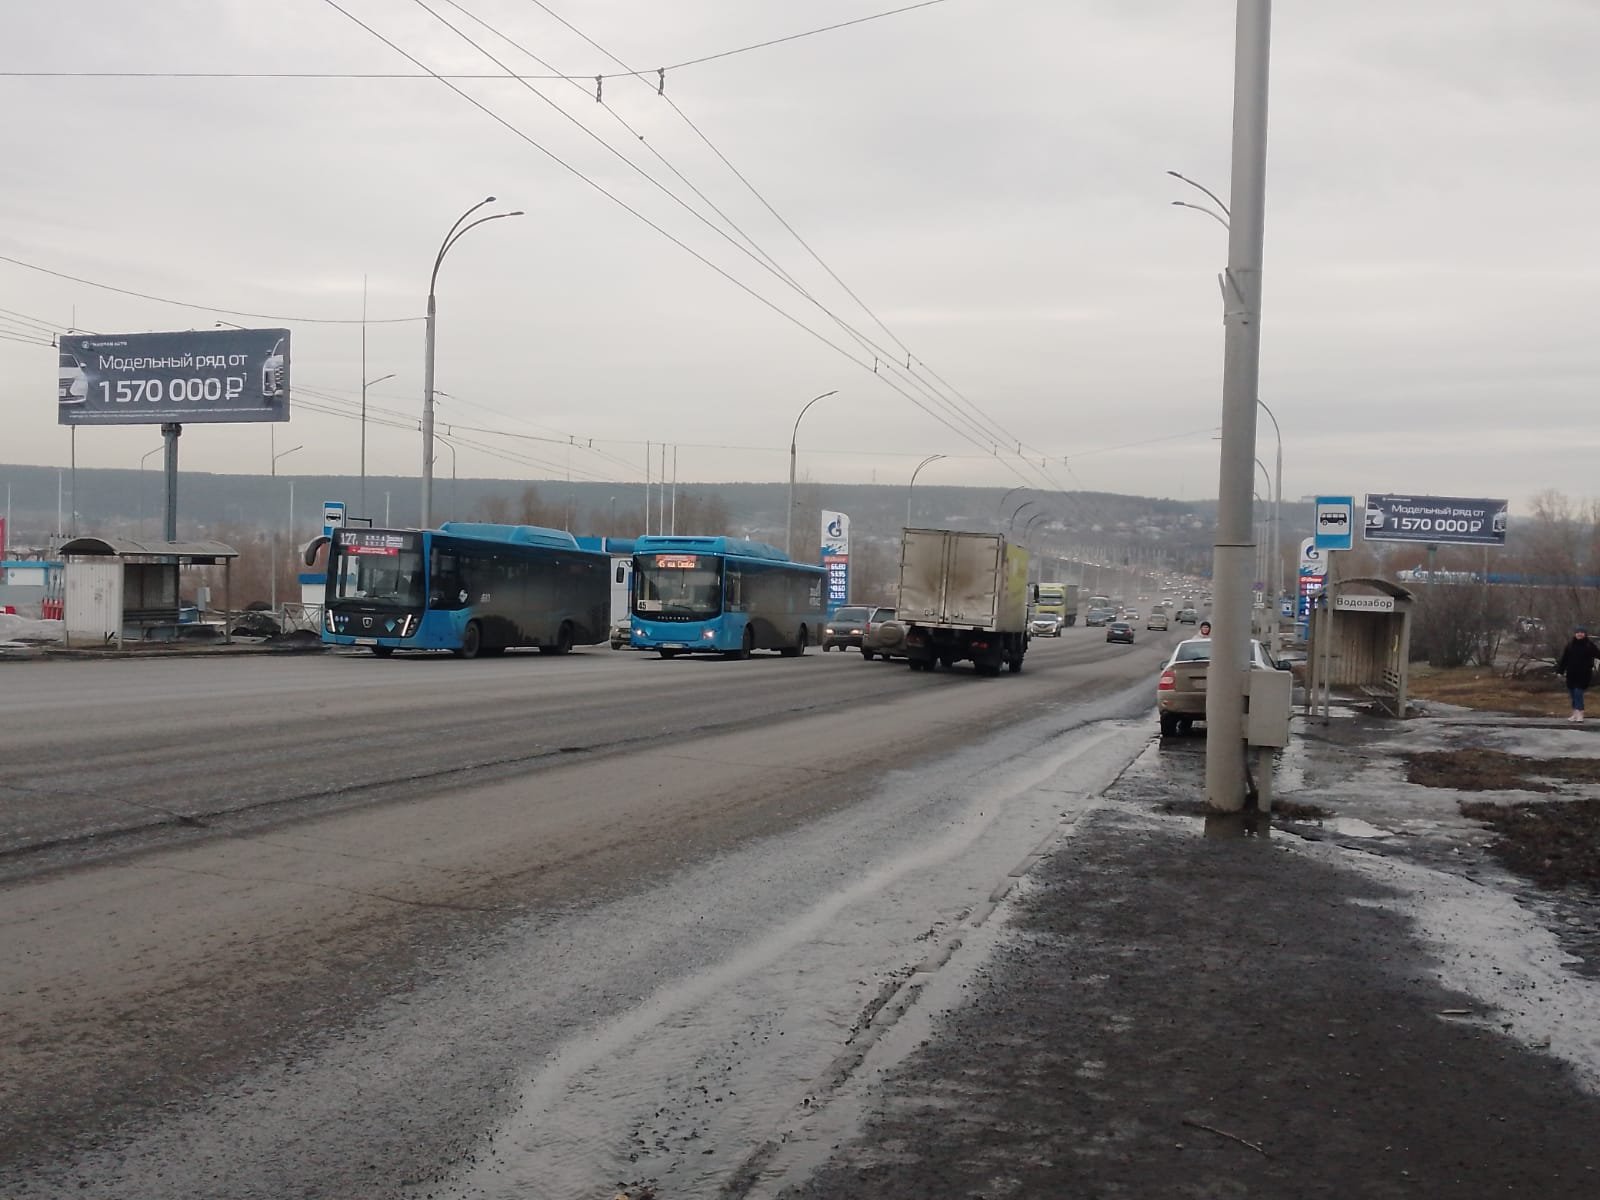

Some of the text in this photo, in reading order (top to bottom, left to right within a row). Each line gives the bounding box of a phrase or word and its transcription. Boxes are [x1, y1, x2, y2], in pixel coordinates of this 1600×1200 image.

[99, 353, 248, 372] Модельный ряд от
[1391, 504, 1451, 516] Модельный
[1452, 508, 1472, 517] ряд
[638, 601, 647, 609] 45
[1336, 597, 1392, 609] Водозабор
